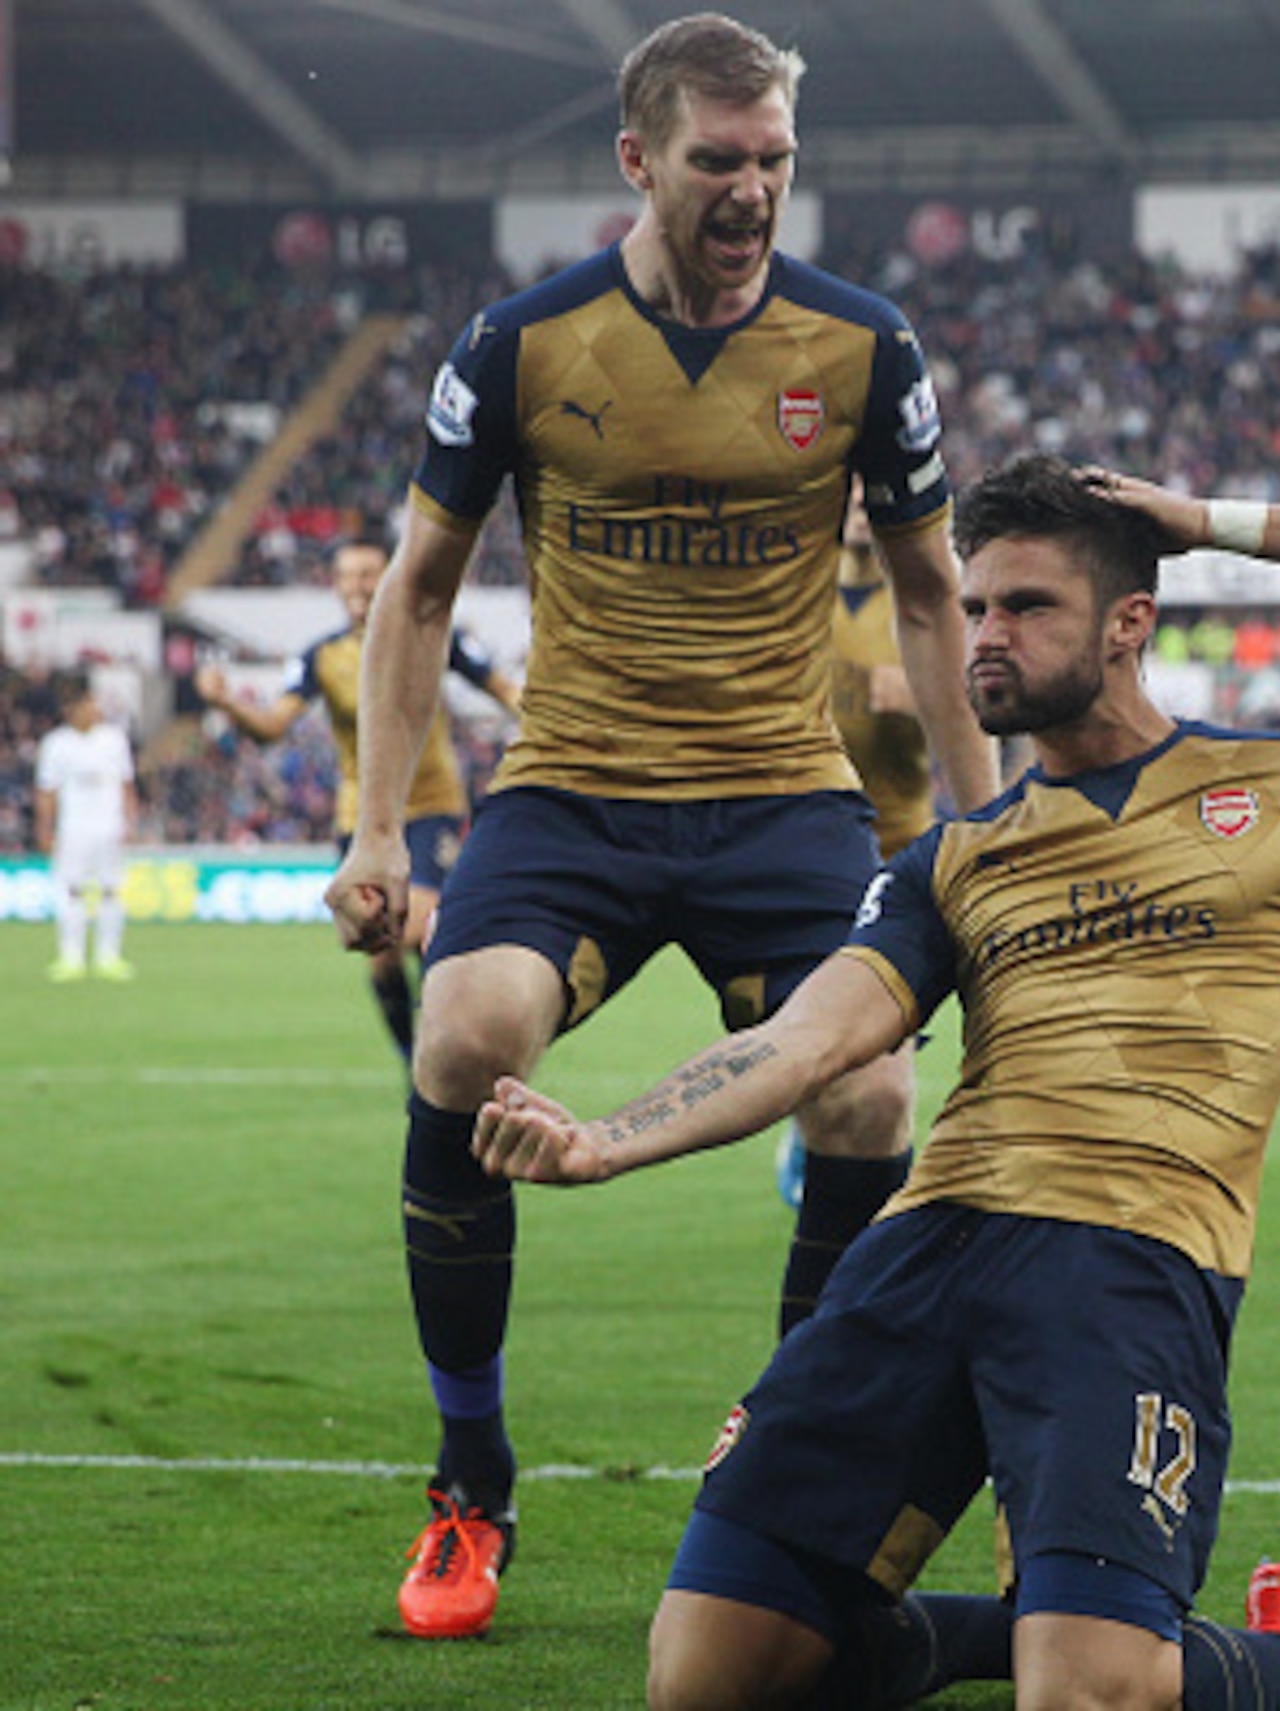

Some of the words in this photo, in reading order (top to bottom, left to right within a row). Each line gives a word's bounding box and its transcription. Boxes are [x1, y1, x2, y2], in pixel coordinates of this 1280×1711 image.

[653, 473, 732, 521] Fly
[567, 500, 801, 567] Emirates
[1069, 879, 1139, 919] Fly
[1126, 1392, 1198, 1516] 12
